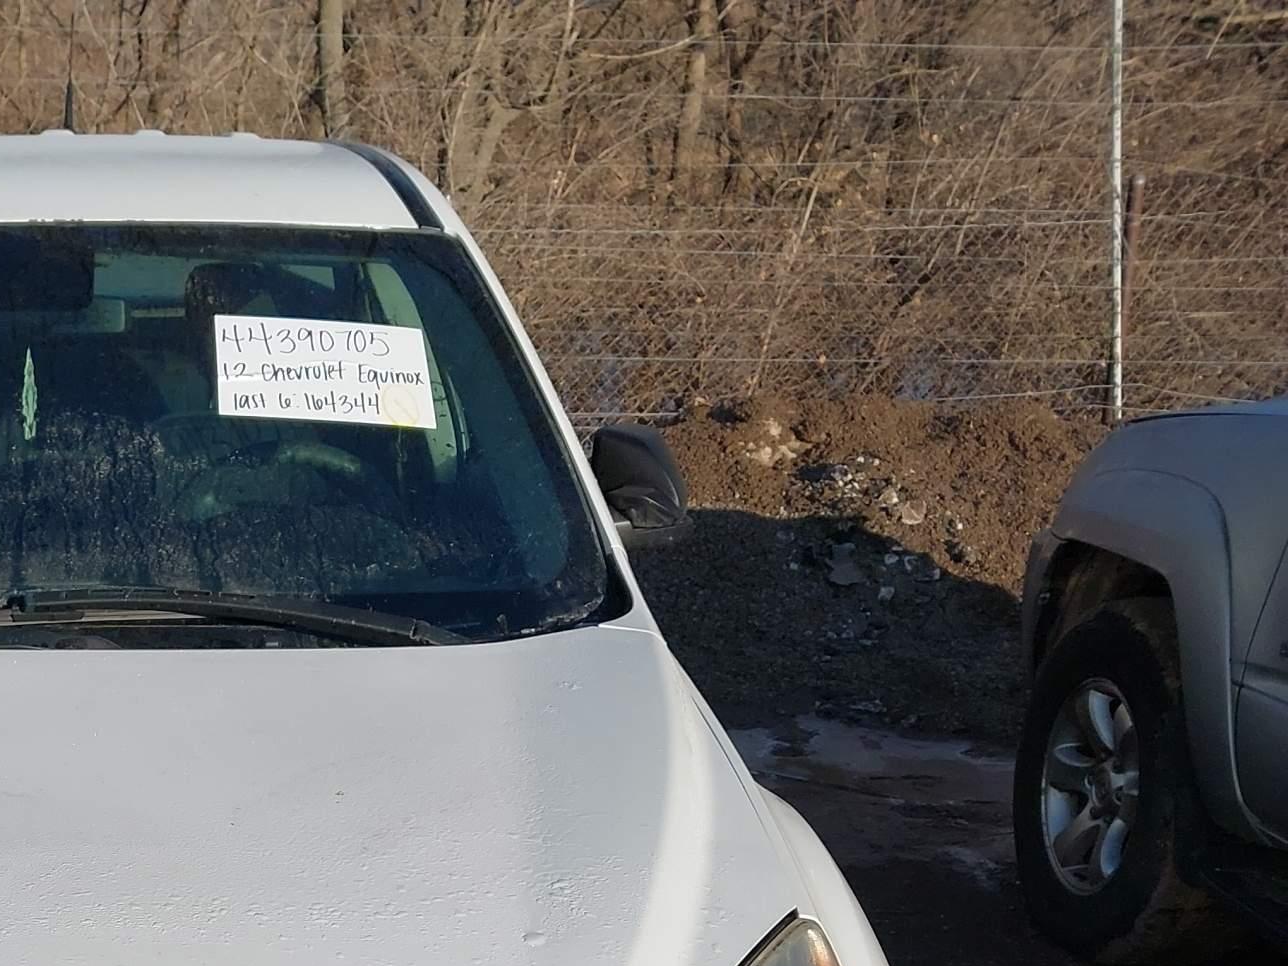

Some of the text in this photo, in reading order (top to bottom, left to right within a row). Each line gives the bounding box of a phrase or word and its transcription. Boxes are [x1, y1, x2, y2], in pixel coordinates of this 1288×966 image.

[221, 322, 390, 356] 44390705
[223, 362, 253, 381] 12
[358, 364, 425, 389] Equinox
[233, 392, 266, 410] last
[304, 391, 380, 414] 164344
